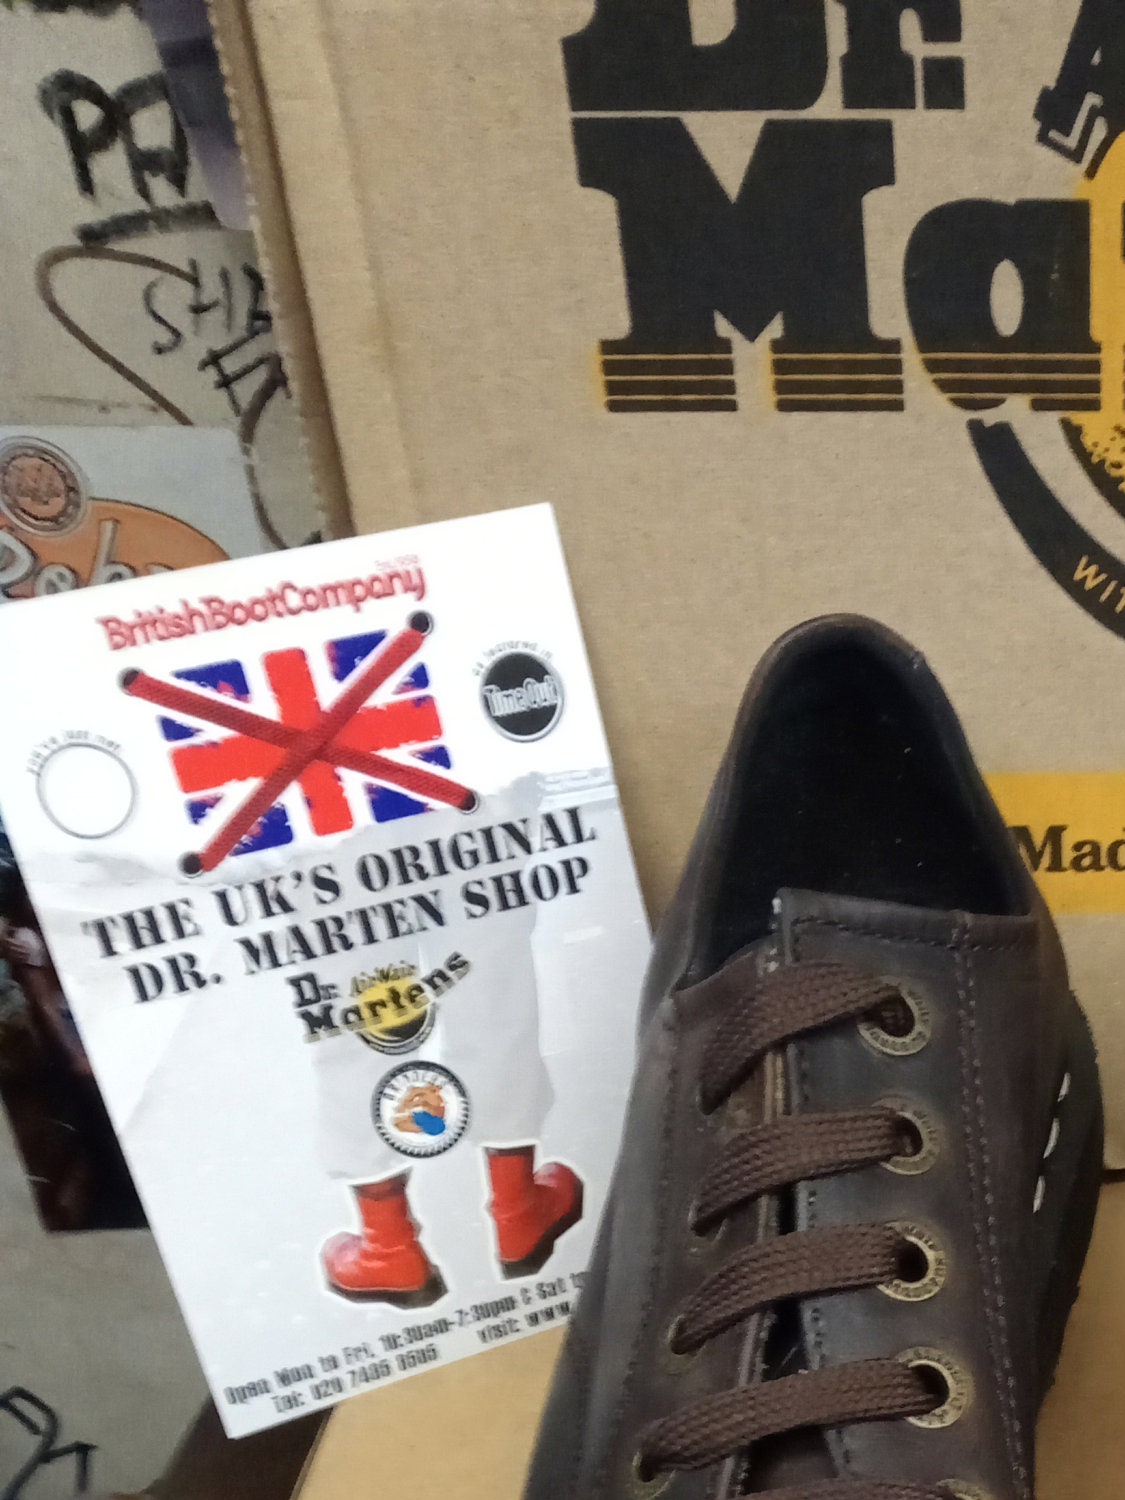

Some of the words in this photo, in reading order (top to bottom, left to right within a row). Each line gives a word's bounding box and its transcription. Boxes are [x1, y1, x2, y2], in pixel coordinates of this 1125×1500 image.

[96, 566, 426, 650] BritishBootCompany
[81, 898, 203, 960] THE
[212, 862, 343, 927] UK'S
[355, 806, 597, 892] ORIGINAL
[121, 950, 222, 1003] DR.
[232, 890, 447, 977] MARTEN
[463, 856, 592, 920] SHOP
[295, 951, 472, 1044] Martens
[224, 1379, 271, 1405] Open
[318, 1355, 339, 1373] to
[535, 1277, 567, 1300] Sat
